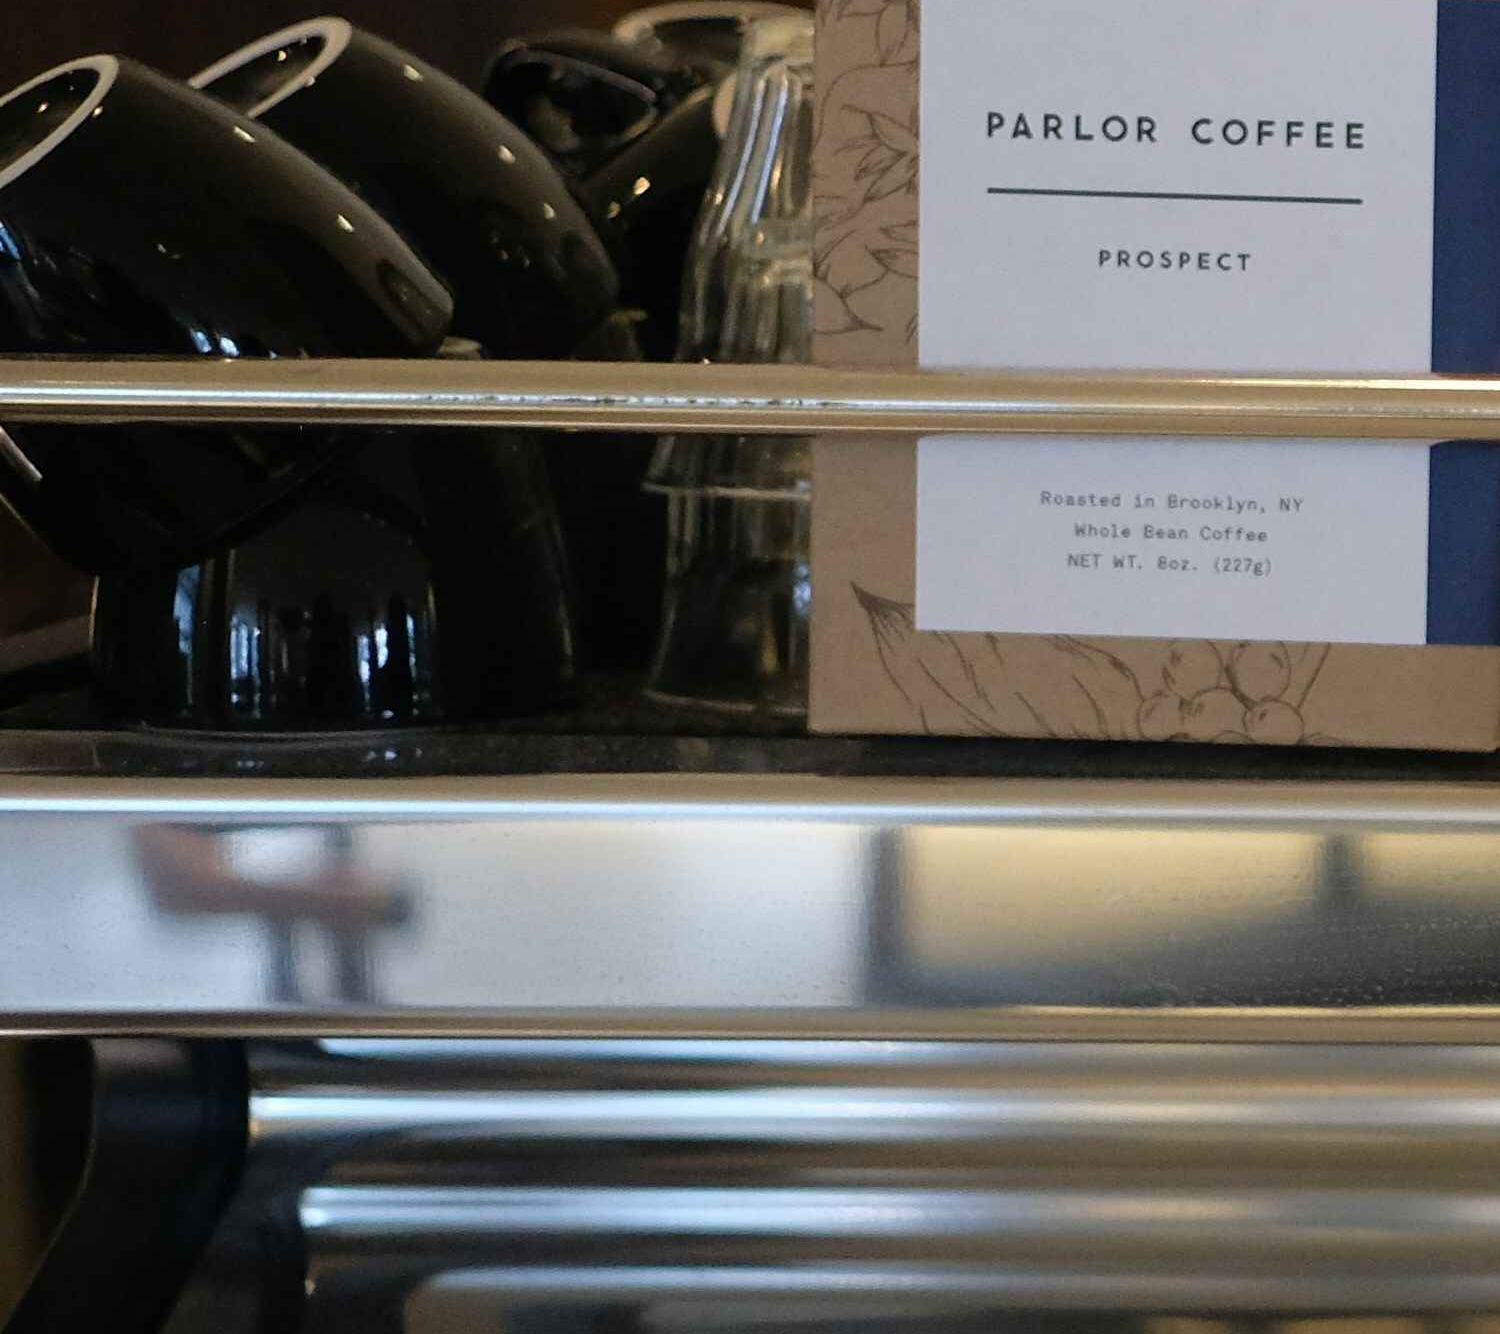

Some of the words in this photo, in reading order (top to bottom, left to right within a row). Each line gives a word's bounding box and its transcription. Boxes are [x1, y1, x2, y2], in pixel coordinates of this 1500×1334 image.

[987, 111, 1156, 144] PARLOR
[1191, 117, 1365, 150] COFFEE
[1098, 249, 1252, 272] PROSPECT
[1040, 490, 1121, 508] Roasted
[1135, 493, 1155, 508] in
[1167, 493, 1266, 514] Brooklyn,
[1279, 497, 1304, 512] NY
[1074, 522, 1131, 539] Whole
[1143, 524, 1189, 540] Bean
[1199, 525, 1268, 543] Coffee
[1066, 553, 1102, 568] NET
[1113, 554, 1143, 571] WT.
[1157, 556, 1199, 572] 8oz.
[1213, 557, 1273, 577] (227g)
